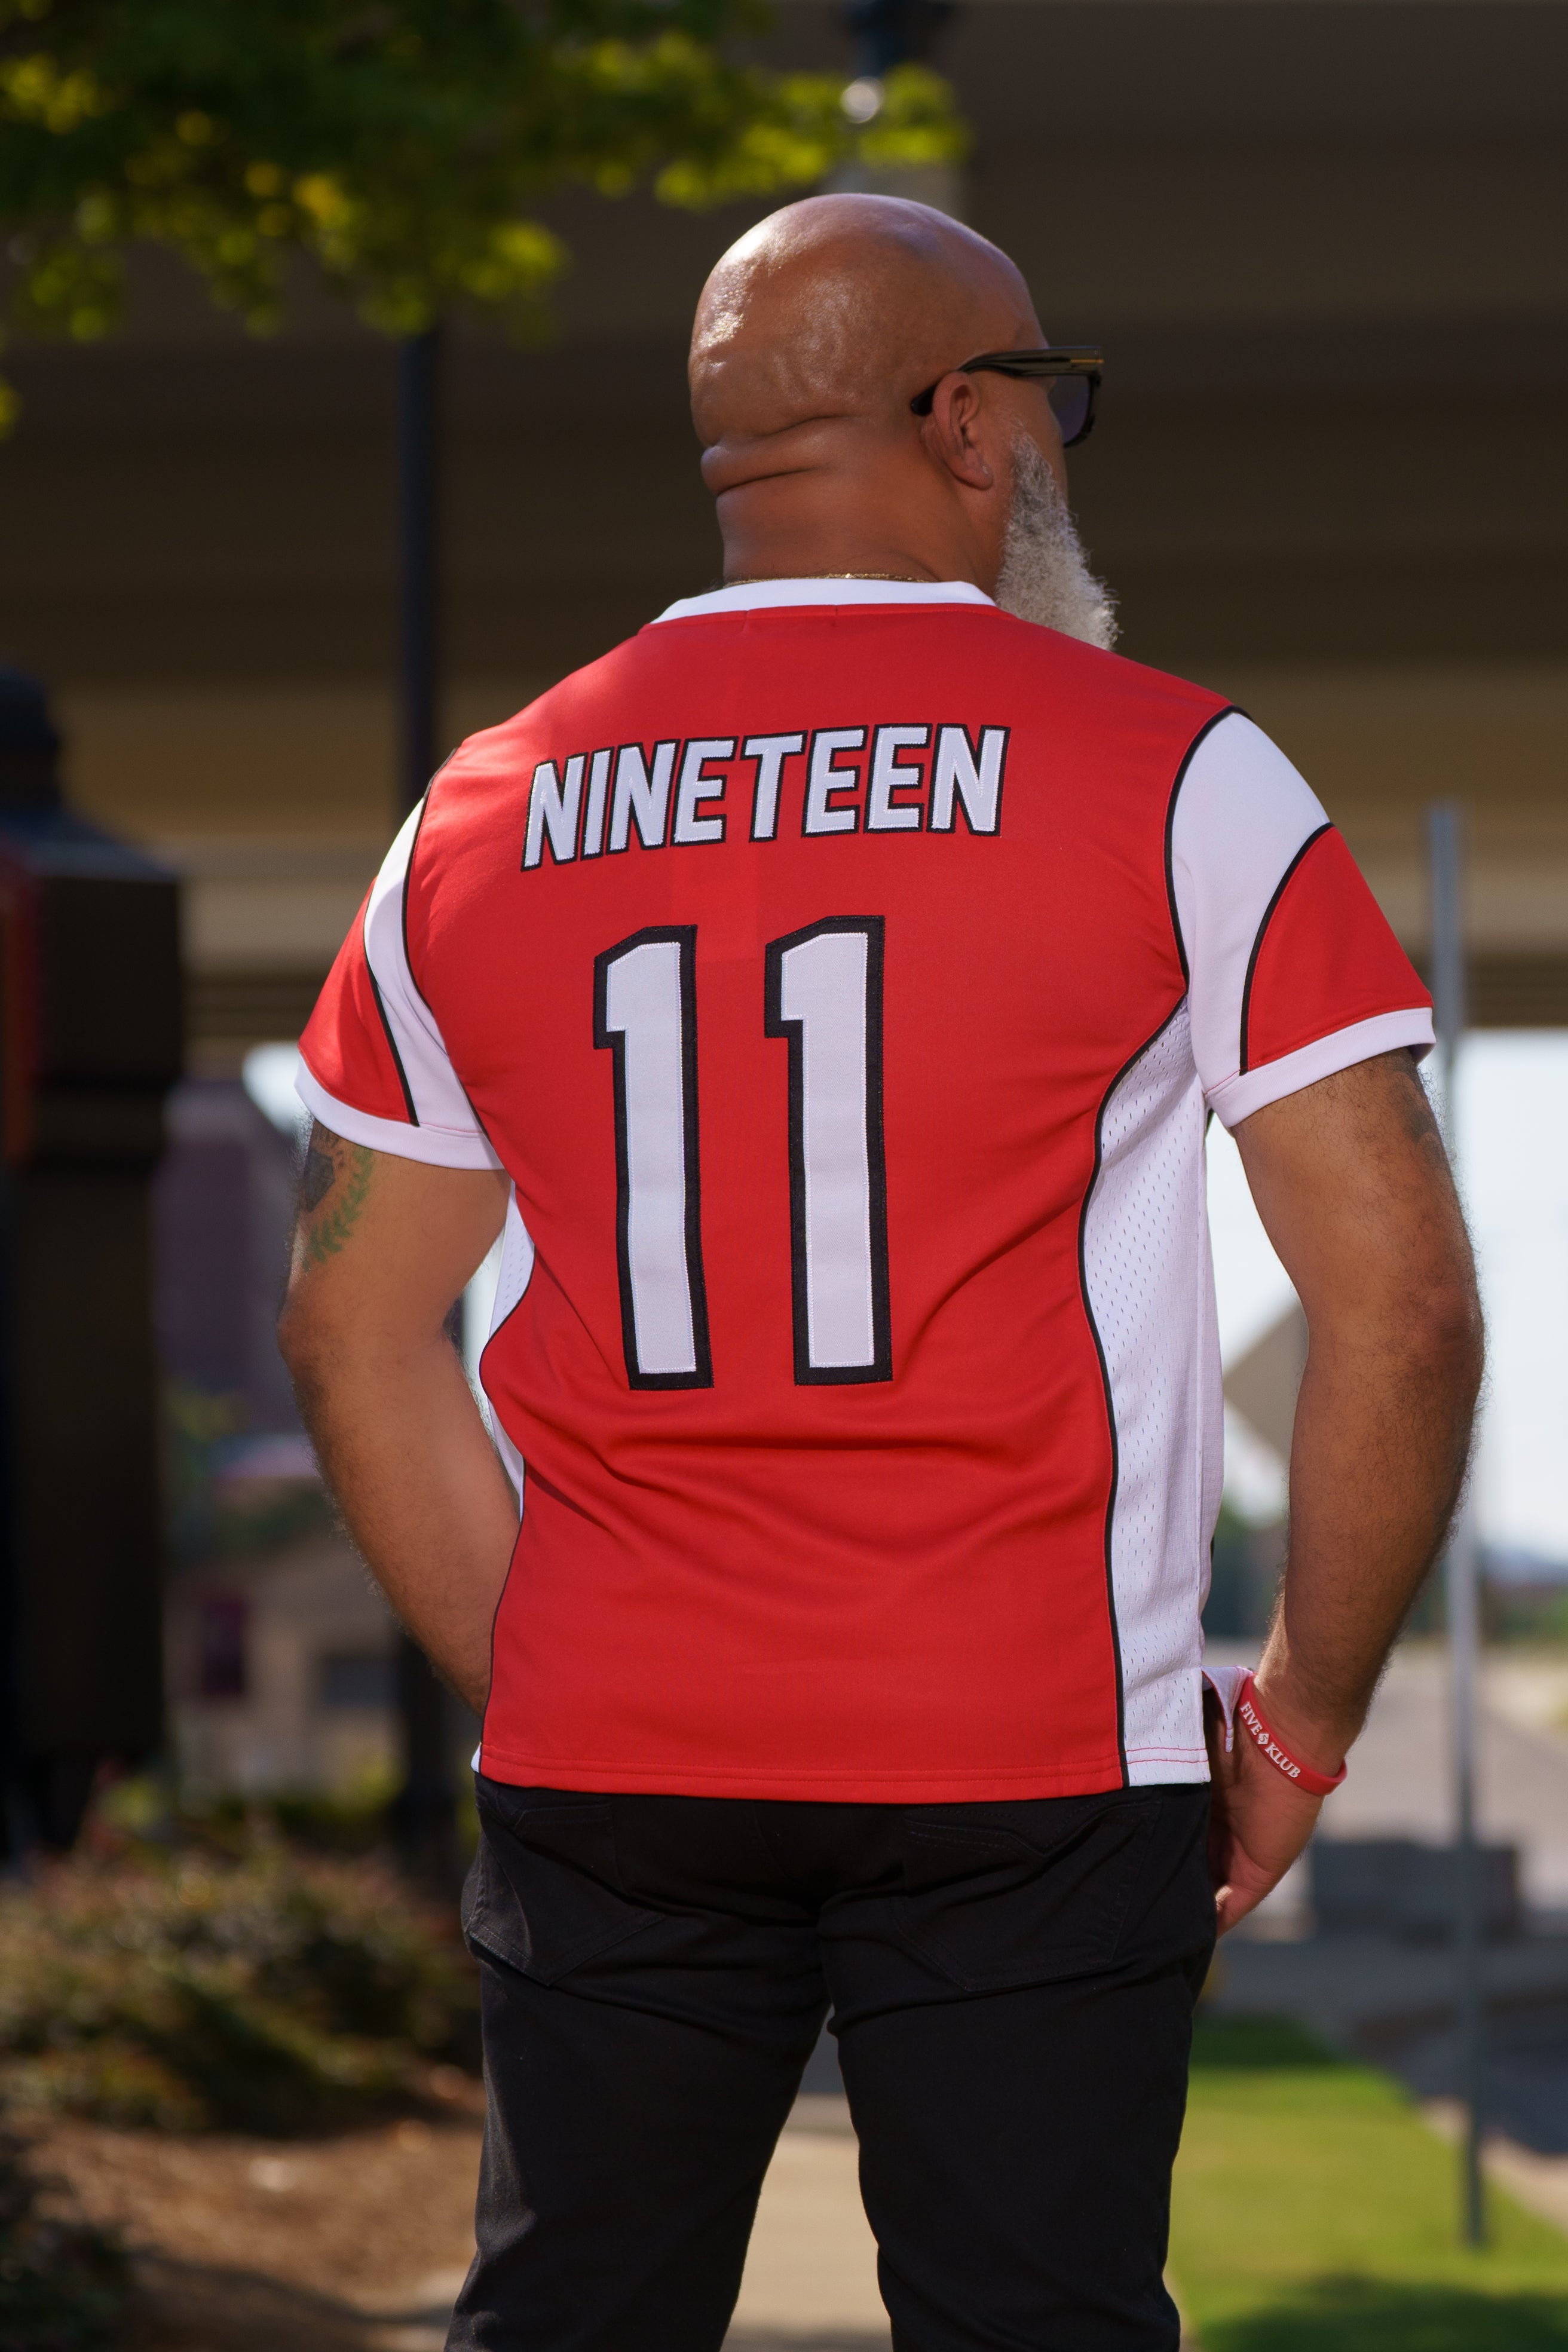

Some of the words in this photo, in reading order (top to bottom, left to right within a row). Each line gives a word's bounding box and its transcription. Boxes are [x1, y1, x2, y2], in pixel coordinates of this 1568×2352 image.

[521, 723, 1010, 871] NINETEEN
[593, 915, 893, 1390] 11
[1240, 1701, 1263, 1736] FIVE
[1264, 1742, 1301, 1778] KLUB
